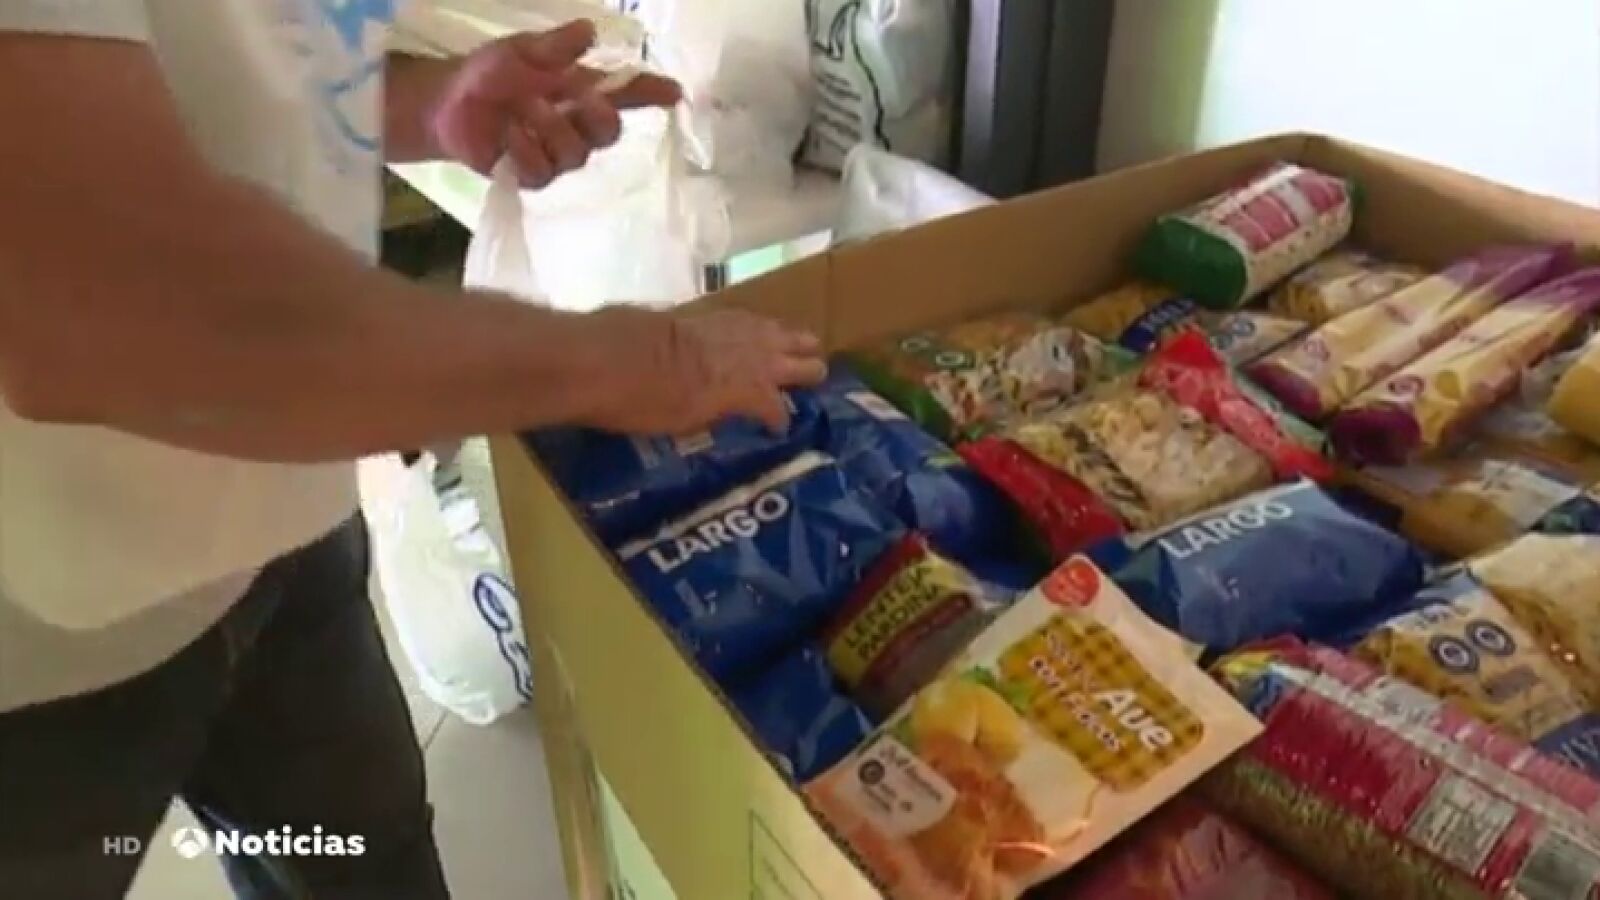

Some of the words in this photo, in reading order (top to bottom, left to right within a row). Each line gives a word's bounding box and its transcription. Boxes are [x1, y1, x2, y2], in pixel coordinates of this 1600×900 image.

[645, 491, 789, 574] LARGO
[1158, 502, 1293, 560] LARGO
[843, 567, 933, 648] LENTEJA
[857, 583, 946, 660] PARDINA
